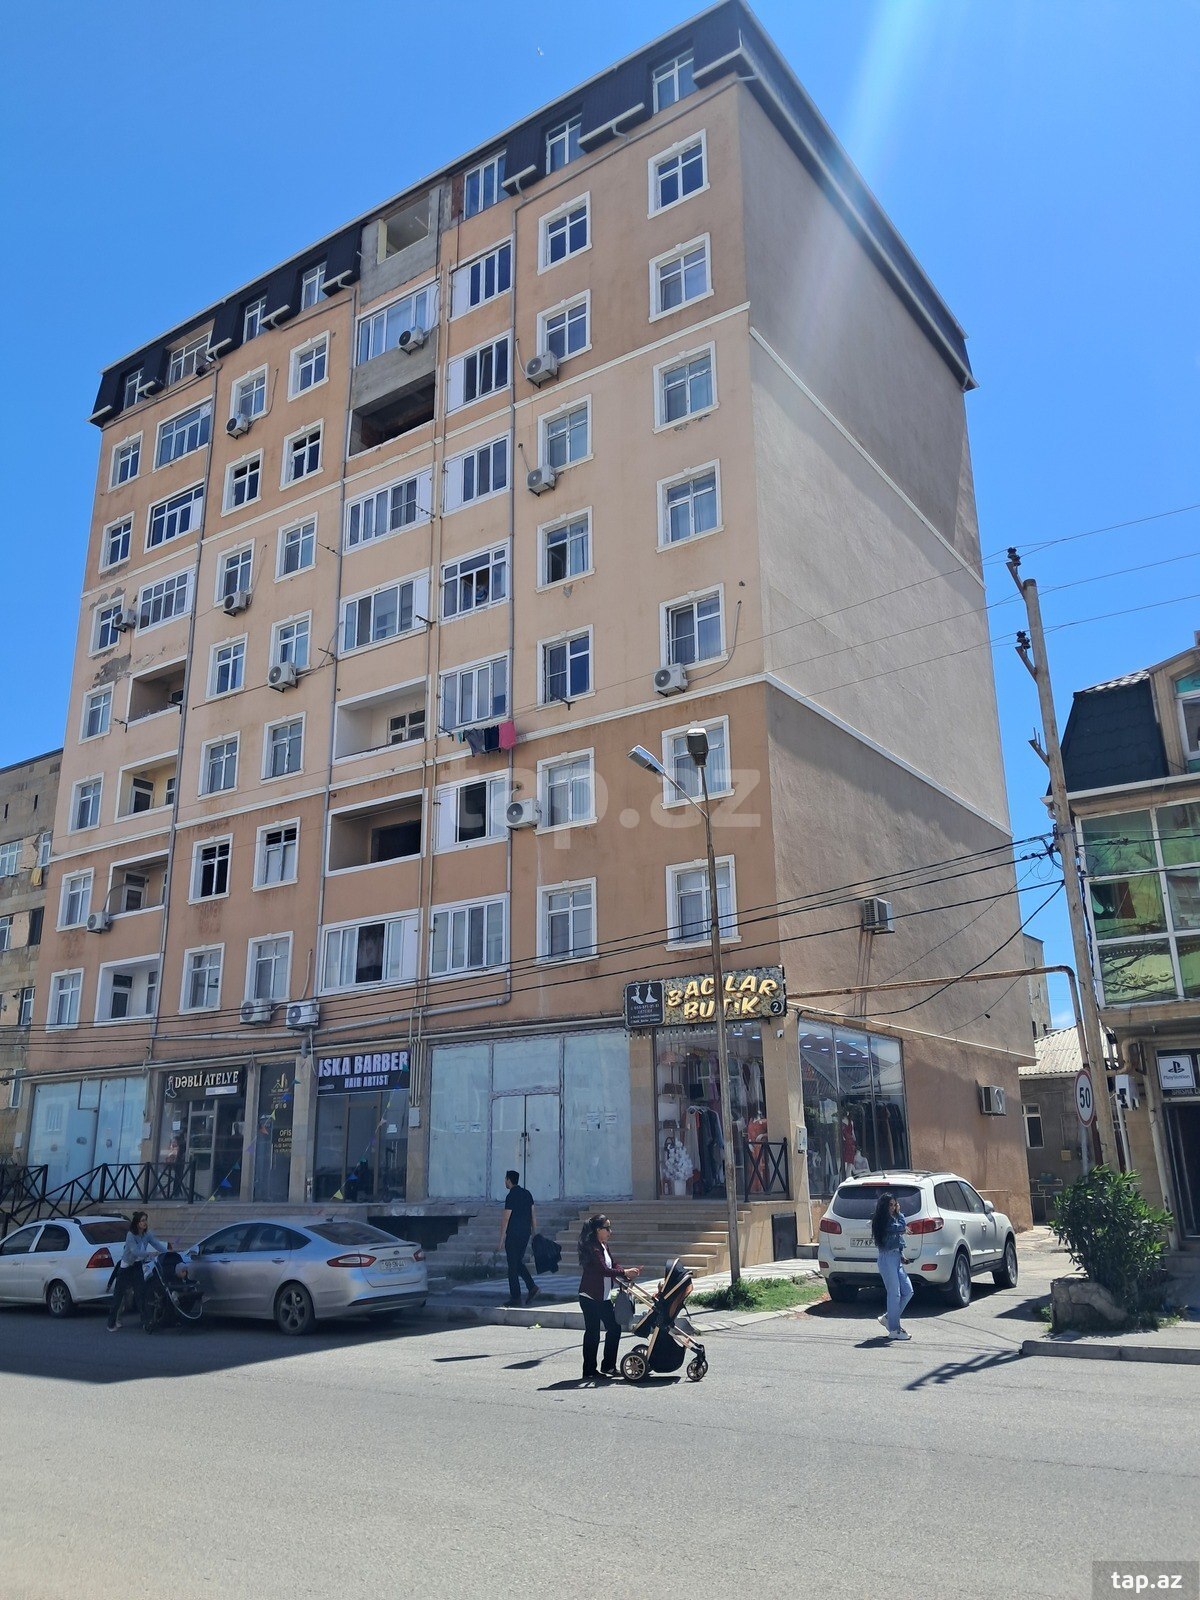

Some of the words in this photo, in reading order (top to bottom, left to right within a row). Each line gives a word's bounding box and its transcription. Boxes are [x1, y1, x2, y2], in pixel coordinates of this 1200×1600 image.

[353, 1051, 408, 1075] BARBER
[174, 1071, 203, 1089] DƏBLİ
[204, 1071, 239, 1086] ATELYE
[344, 1077, 362, 1089] HAIR
[363, 1074, 389, 1087] ARTIST
[1079, 1087, 1091, 1109] 50
